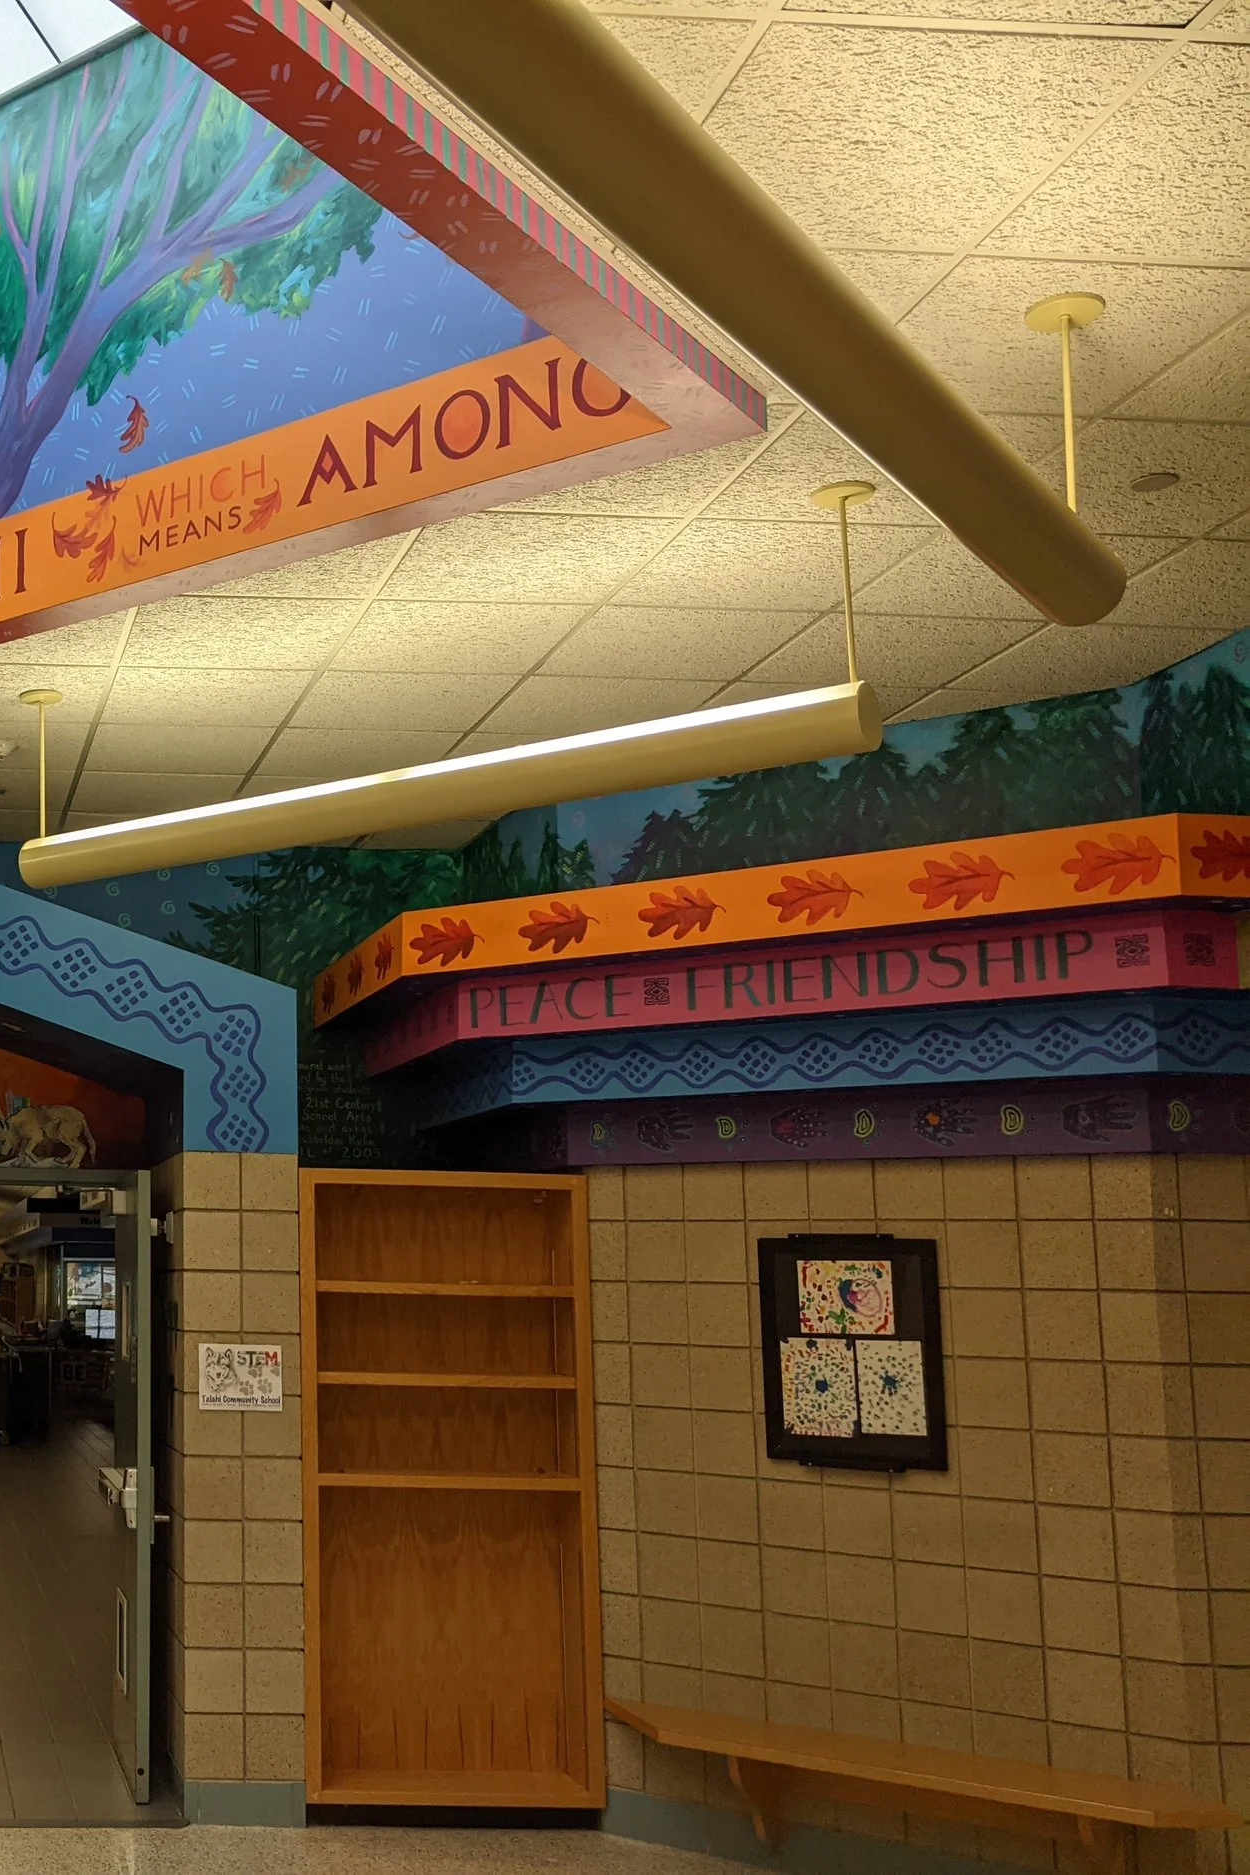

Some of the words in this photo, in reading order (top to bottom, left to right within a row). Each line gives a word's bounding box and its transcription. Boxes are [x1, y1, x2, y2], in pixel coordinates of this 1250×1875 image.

[135, 454, 266, 527] WHICH
[139, 505, 242, 556] MEANS
[468, 972, 633, 1029] PEACE
[685, 930, 1095, 1011] FRIENDSHIP
[236, 1351, 278, 1366] STEM
[202, 1395, 221, 1403] Talahi
[223, 1395, 258, 1405] Community
[261, 1396, 281, 1405] School
